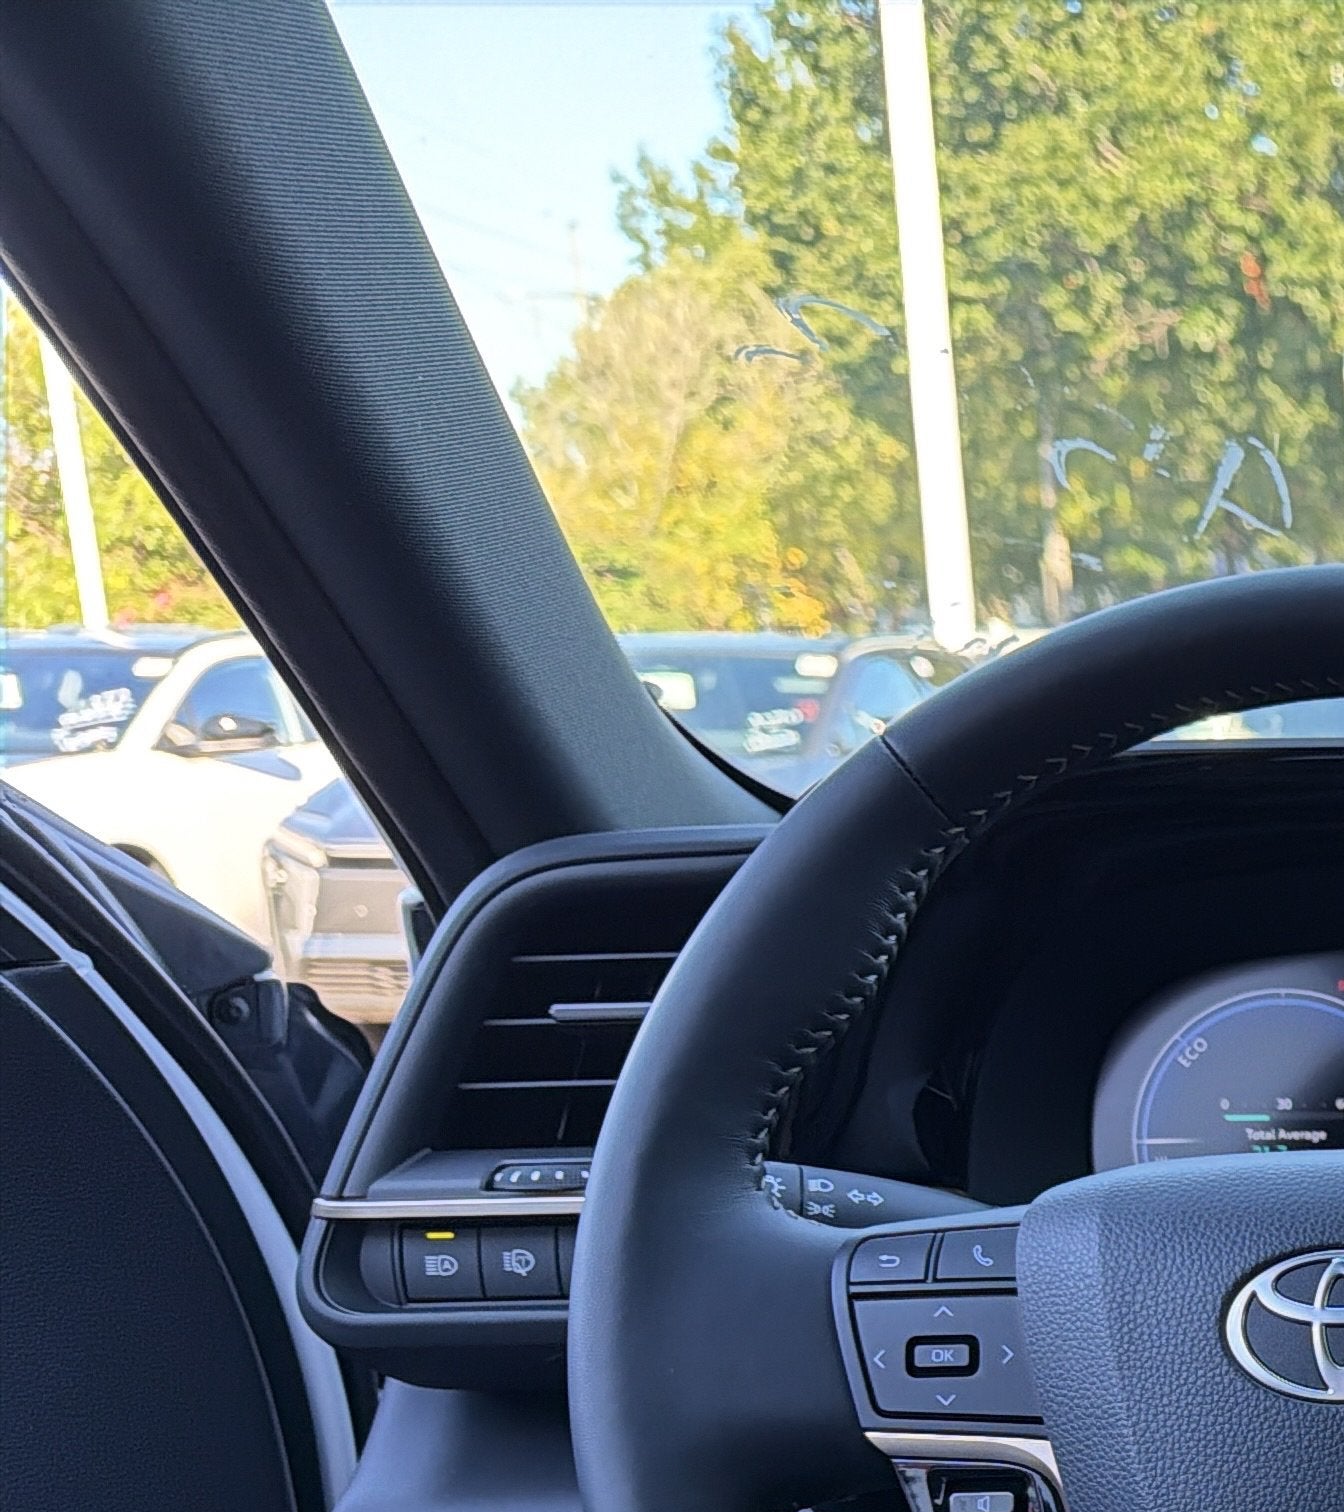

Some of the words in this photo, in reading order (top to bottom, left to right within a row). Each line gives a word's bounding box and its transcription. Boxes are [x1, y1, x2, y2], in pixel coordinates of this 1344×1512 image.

[1176, 1037, 1208, 1068] ECO
[1246, 1128, 1276, 1141] Total
[1278, 1128, 1327, 1143] Average
[931, 1349, 955, 1362] OK
